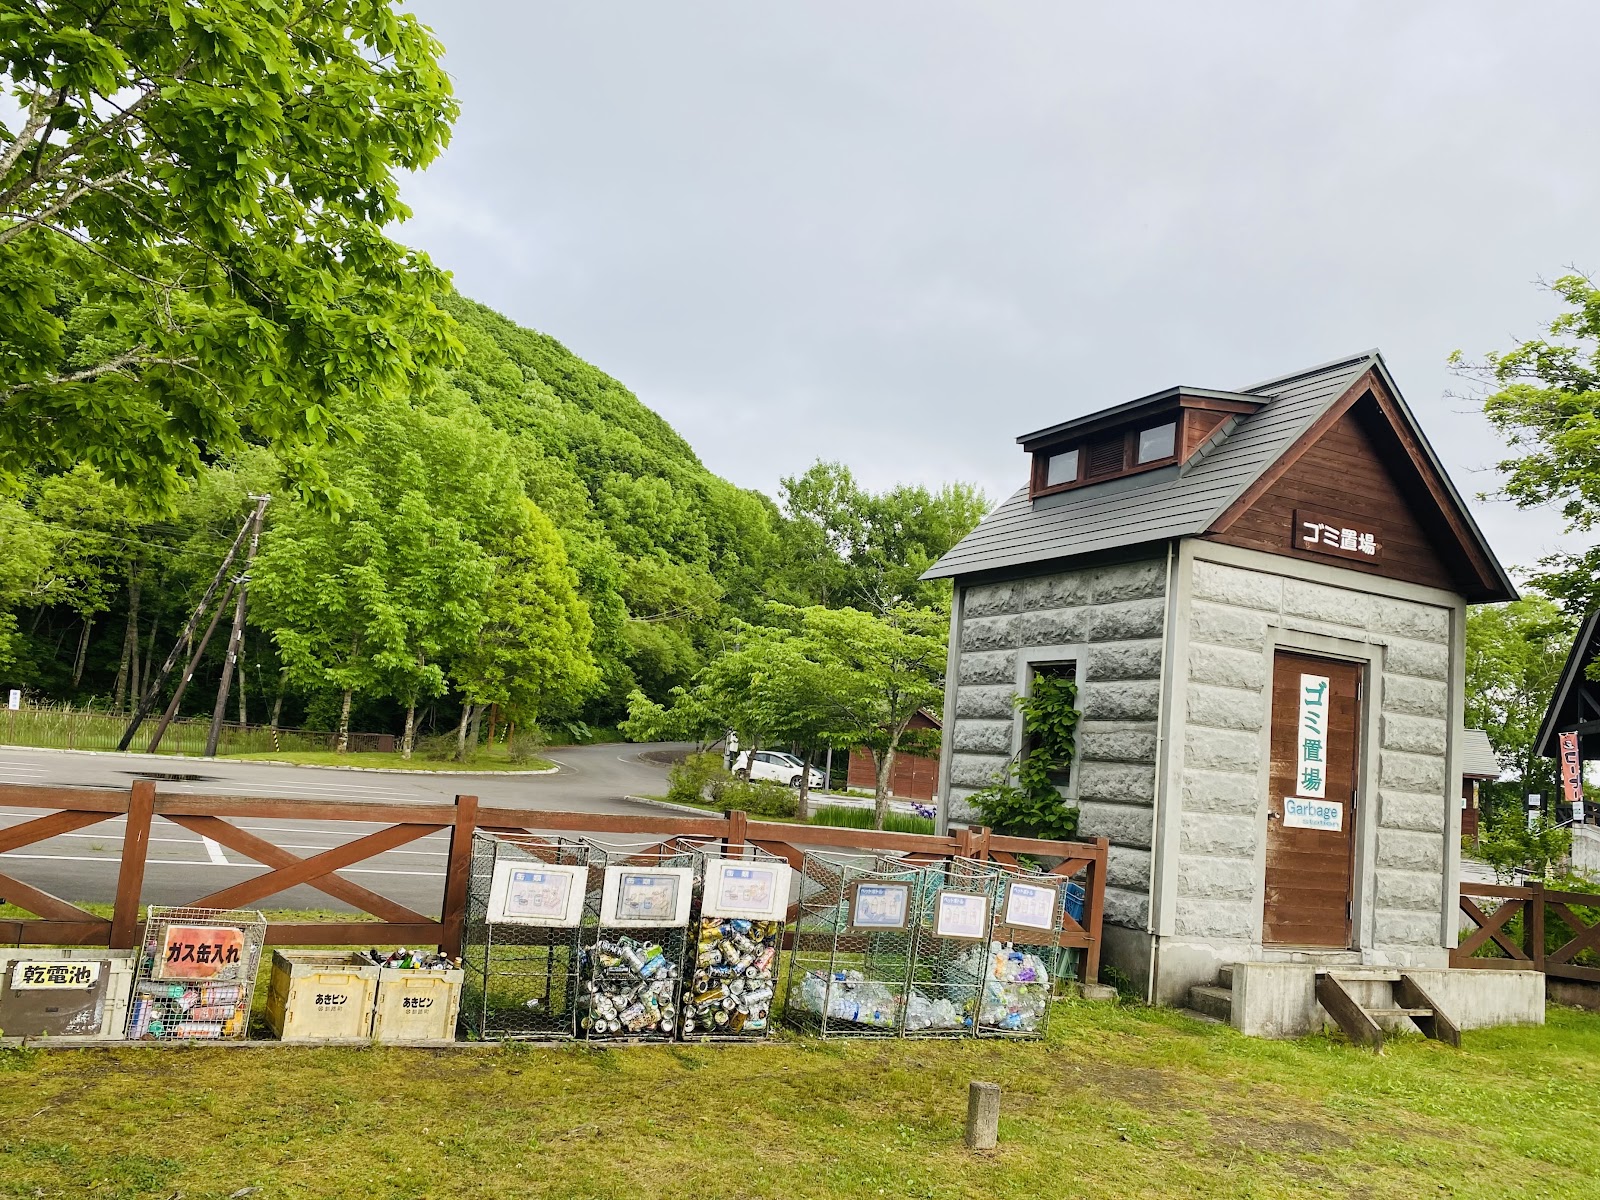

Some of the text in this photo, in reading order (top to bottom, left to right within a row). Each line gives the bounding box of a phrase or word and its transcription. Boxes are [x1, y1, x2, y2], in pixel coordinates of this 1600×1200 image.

[1303, 521, 1377, 556] ゴミ置場
[1301, 680, 1327, 792] ゴミ置場
[1286, 799, 1338, 820] Garbage
[1302, 818, 1340, 827] station
[167, 941, 240, 965] ガス缶入れ
[23, 965, 91, 984] 乾電池
[315, 993, 348, 1005] あきビン
[402, 997, 434, 1008] あきビン
